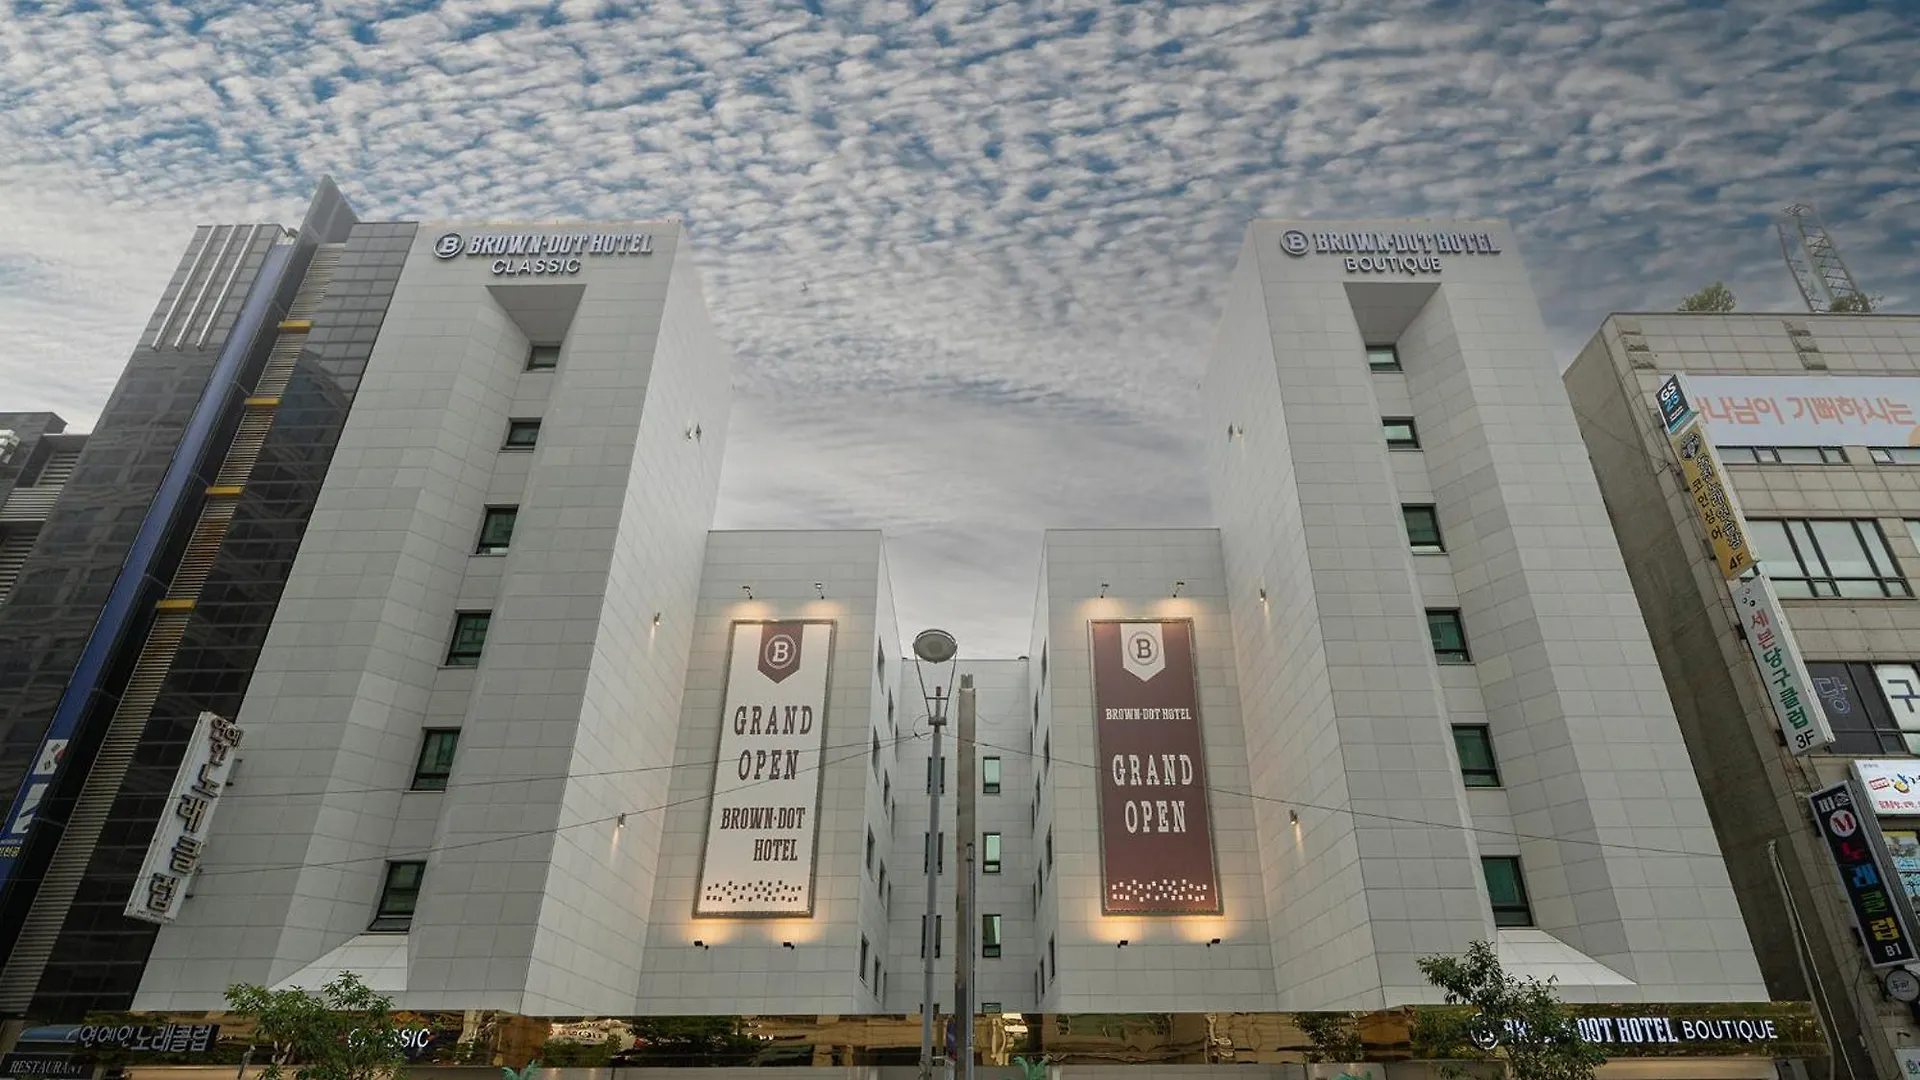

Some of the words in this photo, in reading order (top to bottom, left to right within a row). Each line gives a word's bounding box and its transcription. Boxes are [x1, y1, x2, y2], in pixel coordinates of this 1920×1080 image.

[589, 233, 653, 255] HOTEL
[1433, 232, 1501, 254] HOTEL
[491, 258, 581, 275] CLASSIC
[1344, 256, 1443, 276] BOUTIQUE
[1660, 382, 1676, 402] GS
[1664, 391, 1680, 413] 25
[1694, 397, 1784, 425] 나님이
[1787, 397, 1917, 425] 기뻐하시는
[1729, 552, 1744, 571] 4F
[734, 705, 813, 736] GRAND
[1162, 707, 1192, 721] HOTEL
[1795, 729, 1815, 750] 3F
[739, 749, 800, 781] OPEN
[1112, 754, 1193, 786] GRAND
[1124, 800, 1187, 834] OPEN
[753, 838, 799, 862] HOTEL
[1619, 1017, 1679, 1043] HOTEL
[1682, 1019, 1778, 1042] BOUTIQUE
